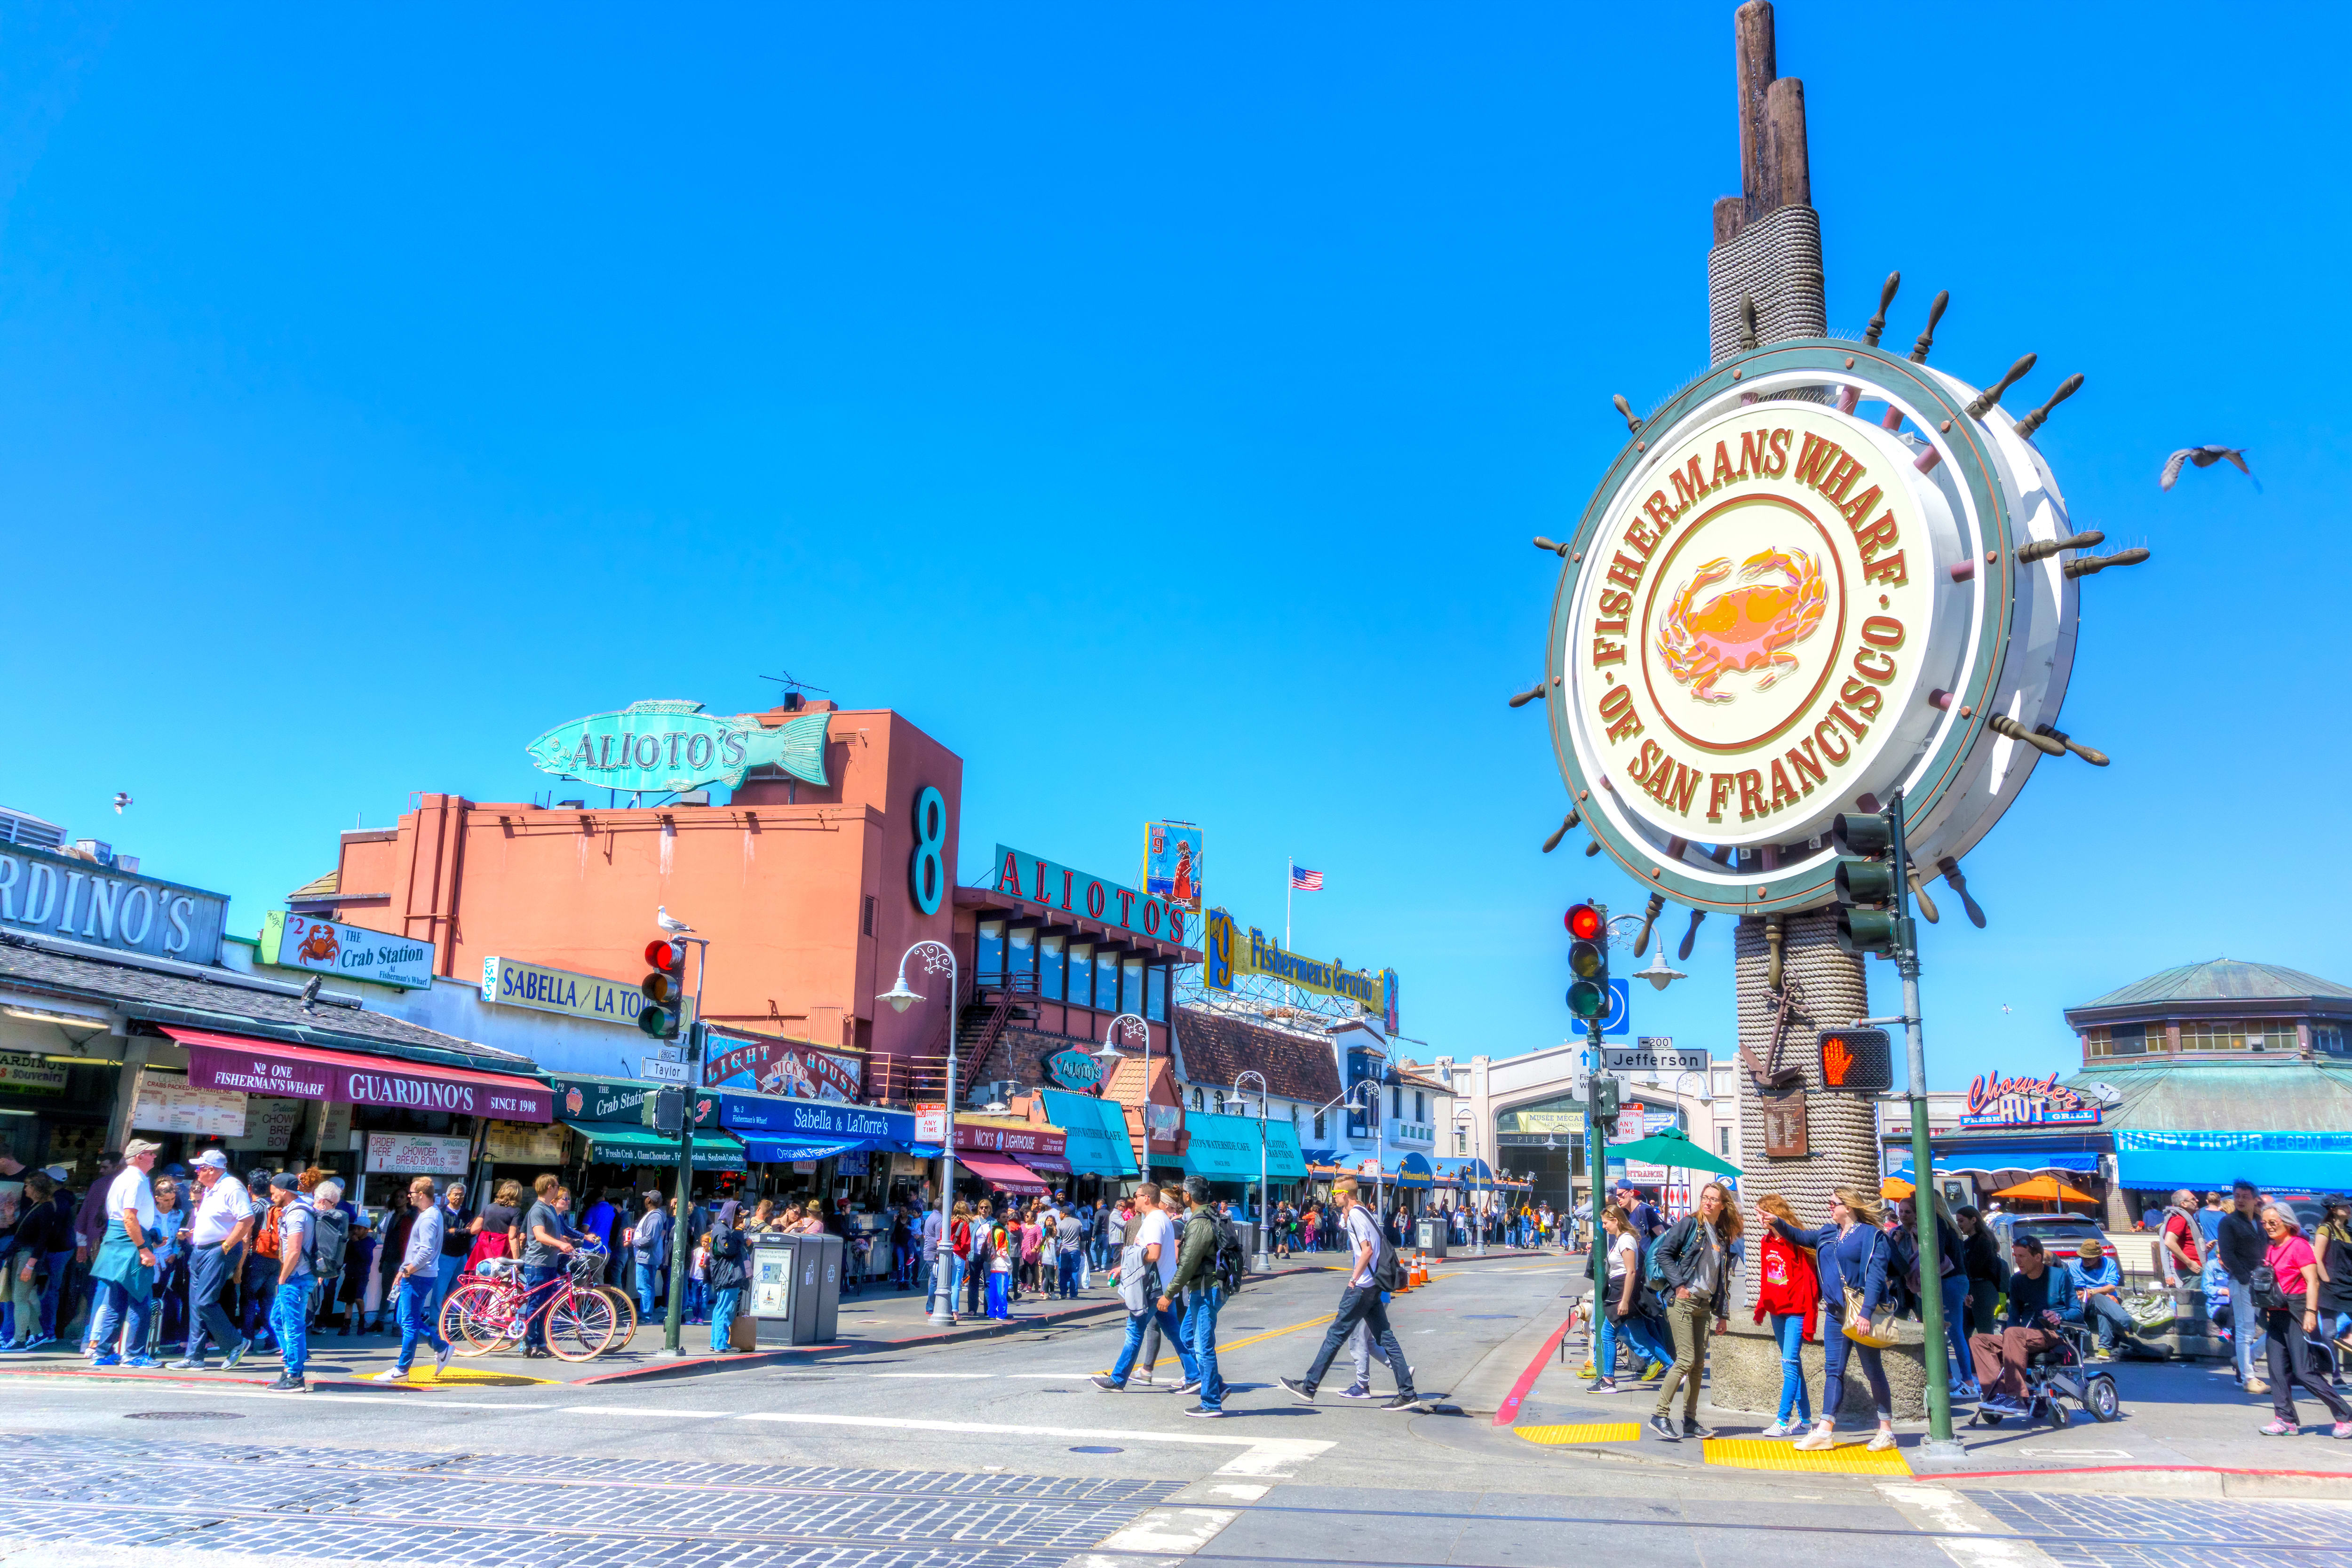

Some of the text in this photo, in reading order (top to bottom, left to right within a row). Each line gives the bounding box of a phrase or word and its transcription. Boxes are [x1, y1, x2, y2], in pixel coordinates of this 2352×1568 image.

[1593, 427, 1909, 667] FISHERMANS WHARF
[1598, 614, 1906, 824] OF SAN FRANCISCO
[570, 727, 748, 770] ALIOTO'S
[913, 786, 946, 915] 8
[1152, 837, 1164, 854] 9
[999, 852, 1184, 943] ALIOTO'S
[288, 916, 304, 935] #2
[345, 930, 362, 943] THE
[342, 945, 423, 968] Crab Station
[1218, 916, 1235, 987] 9
[1250, 926, 1373, 1002] Fishermen's Grotto
[379, 971, 428, 986] Fisherman's Wharf
[503, 967, 577, 1008] SABELLA
[595, 986, 614, 1014] LA
[1650, 1038, 1669, 1047] 200
[1613, 1053, 1699, 1066] Jefferson
[12, 1069, 63, 1082] souvenirs
[271, 1065, 293, 1078] ONE
[655, 1063, 680, 1078] Taylor
[707, 1045, 858, 1101] LIGHT HOUSE
[773, 1061, 807, 1081] NICK'S
[1063, 1061, 1101, 1081] ALIOTO'S
[147, 1081, 167, 1089] CRABS
[215, 1071, 325, 1095] FISHERMAN'S WHARF
[349, 1073, 473, 1111] GUARDINO'S
[1967, 1070, 2081, 1114] Chowder
[491, 1097, 536, 1113] SINCE 1908
[596, 1099, 618, 1116] Crab
[2000, 1098, 2046, 1122] HUT
[732, 1115, 755, 1123] Fisherman's
[794, 1107, 888, 1135] Sabella & LaTorre's
[371, 1137, 396, 1147] ORDER
[410, 1137, 432, 1147] Delicious
[974, 1129, 994, 1146] NICK'S
[1005, 1132, 1035, 1150] LIGHTHOUSE
[1105, 1130, 1123, 1141] CAFE
[2119, 1131, 2321, 1151] HAPPY HOUR 4-6PM
[372, 1147, 392, 1156] HERE
[402, 1146, 437, 1156] CHOWDER
[595, 1146, 602, 1155] #2
[1207, 1139, 1251, 1151] WATERSIDE CAFE
[1267, 1140, 1288, 1149] ALIOTO'S
[396, 1155, 445, 1166] BREAD BOWLS
[605, 1149, 620, 1158] Fresh
[621, 1149, 633, 1159] Crab
[637, 1151, 650, 1159] Clam
[650, 1152, 670, 1160] Chowder
[708, 1153, 726, 1162] Seafood
[777, 1148, 810, 1159] ORIGINAL
[1149, 1157, 1178, 1165] ENTRANCE
[1266, 1149, 1294, 1159] CRAB STAND
[795, 1161, 815, 1170] ENTRANCE
